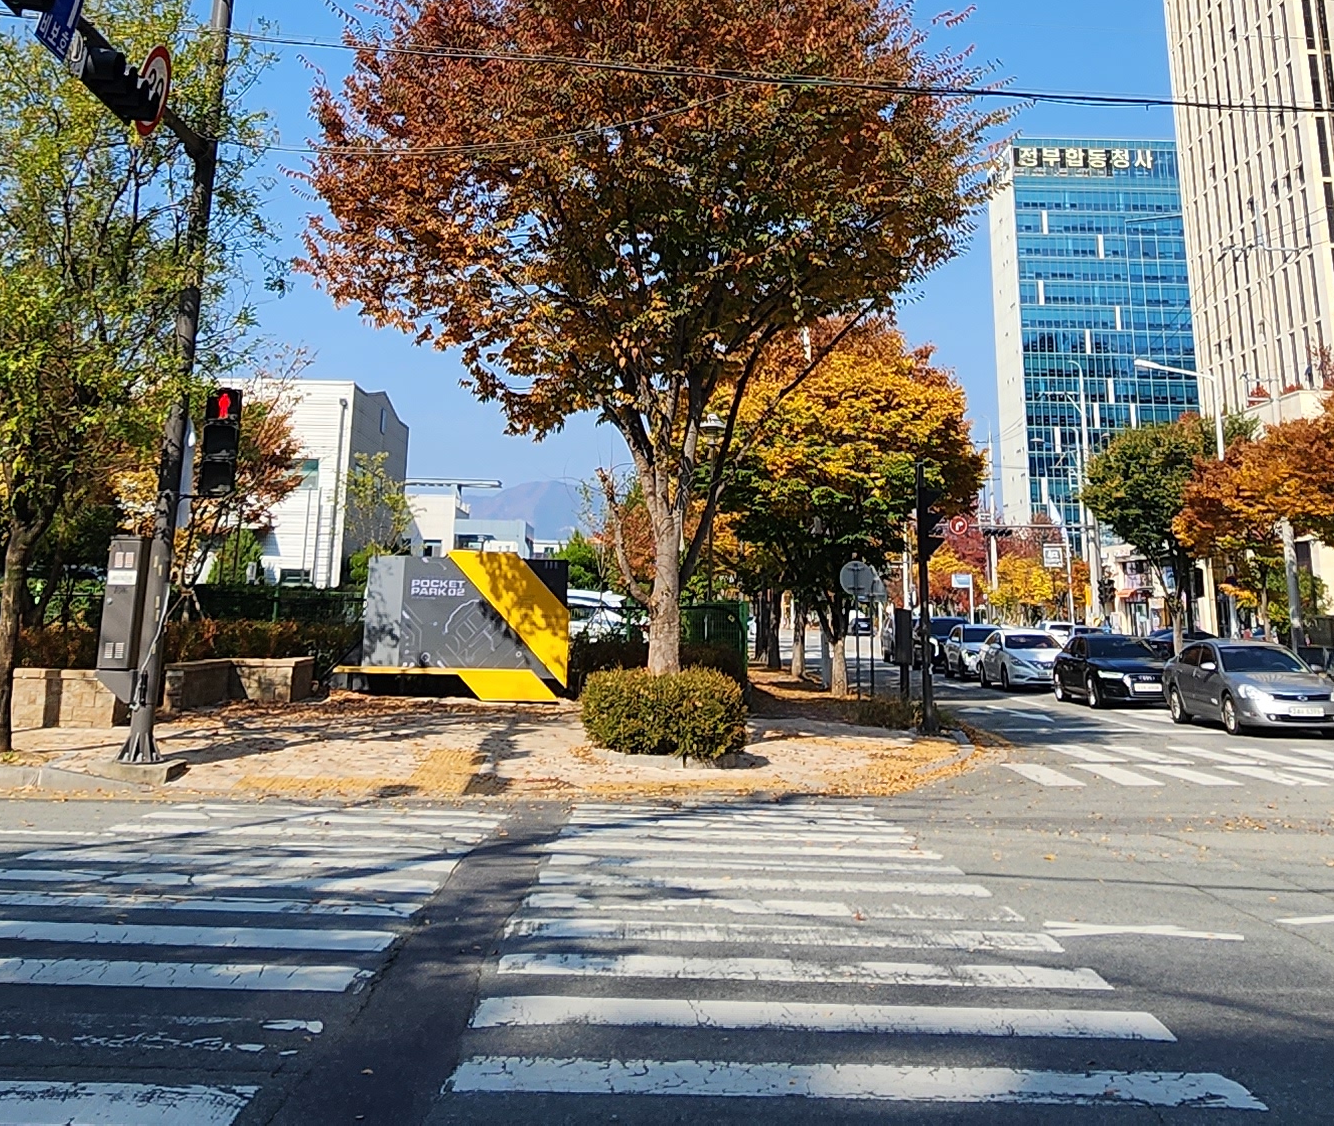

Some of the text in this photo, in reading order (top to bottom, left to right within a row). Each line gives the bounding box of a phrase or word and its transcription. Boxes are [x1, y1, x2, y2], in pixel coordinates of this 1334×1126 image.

[39, 13, 69, 56] 비보호
[1019, 147, 1153, 169] 정부합동청사
[411, 579, 466, 588] POCKET
[411, 588, 465, 596] PARK 02
